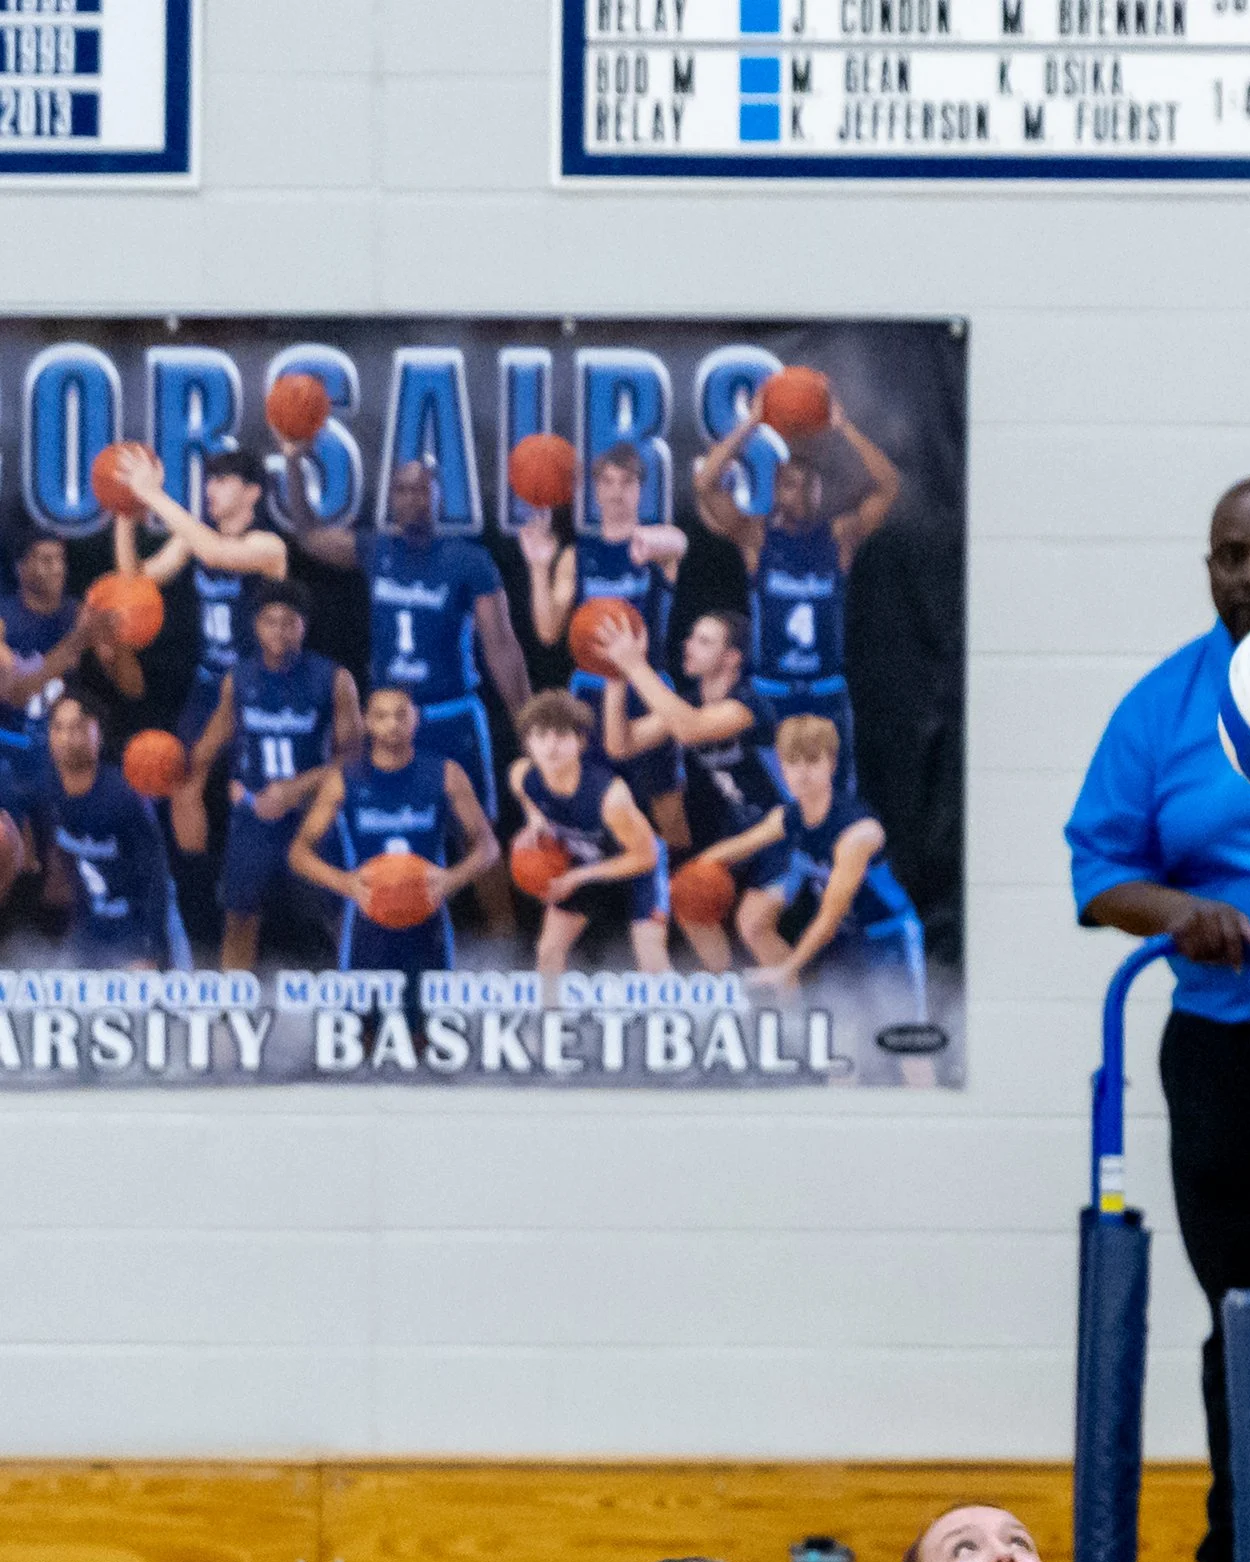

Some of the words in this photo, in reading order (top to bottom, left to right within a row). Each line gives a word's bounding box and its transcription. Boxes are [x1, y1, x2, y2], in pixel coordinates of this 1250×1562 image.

[672, 55, 695, 95] M
[595, 101, 685, 142] RELAY
[837, 101, 989, 141] JEFFERSON
[1076, 101, 1178, 143] FUERST
[0, 969, 262, 1013] ATERFORD
[277, 969, 408, 1013] MOTT
[420, 970, 543, 1014] HIGH
[557, 971, 751, 1015] SCHOOL
[314, 1009, 853, 1072] BASKETBALL
